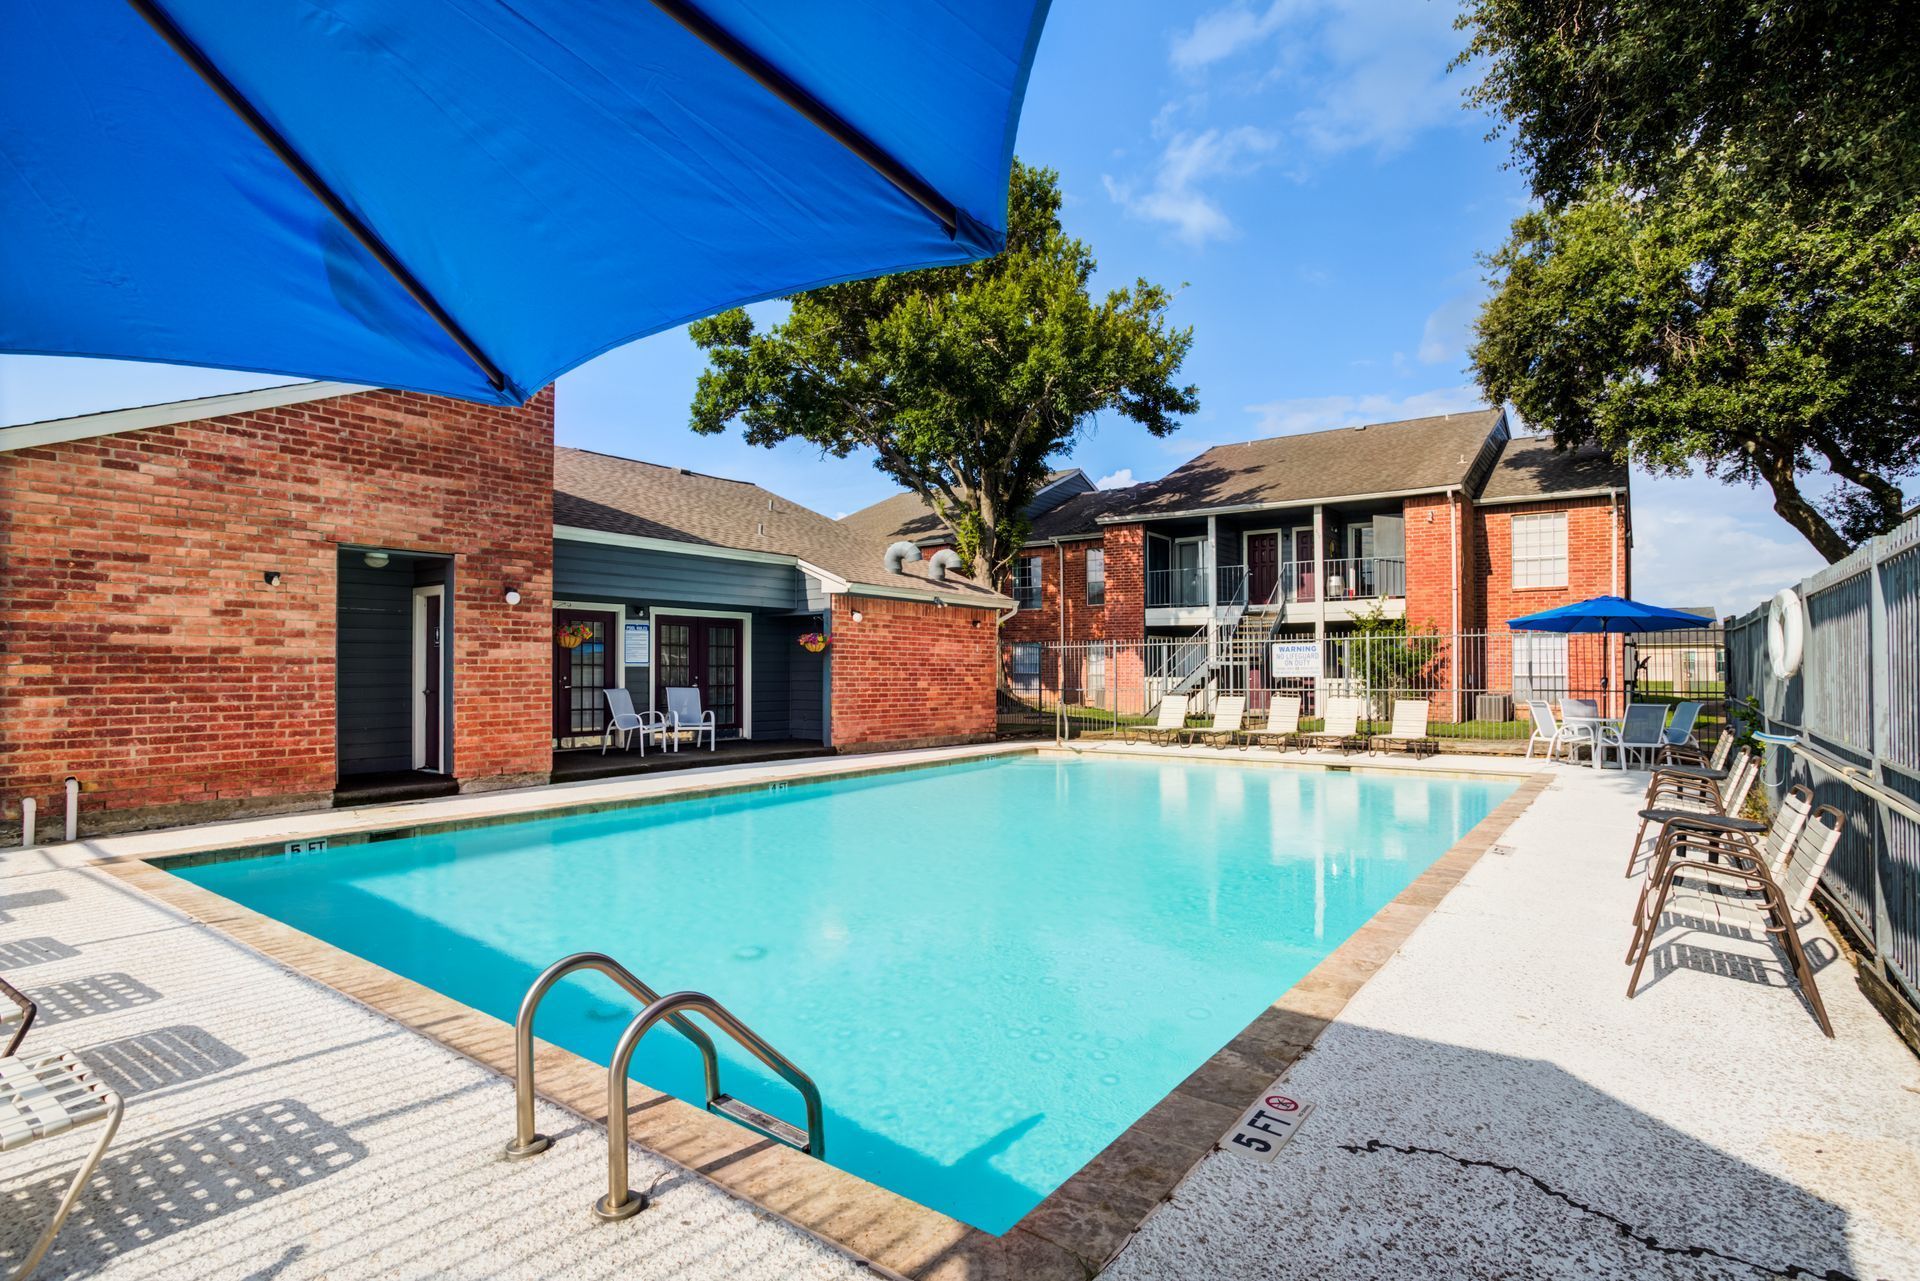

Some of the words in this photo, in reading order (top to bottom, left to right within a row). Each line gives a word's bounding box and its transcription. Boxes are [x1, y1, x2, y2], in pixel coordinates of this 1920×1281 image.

[291, 844, 301, 853] 5
[308, 840, 326, 852] FT
[1247, 1110, 1291, 1137] FT
[1232, 1133, 1271, 1153] 5
